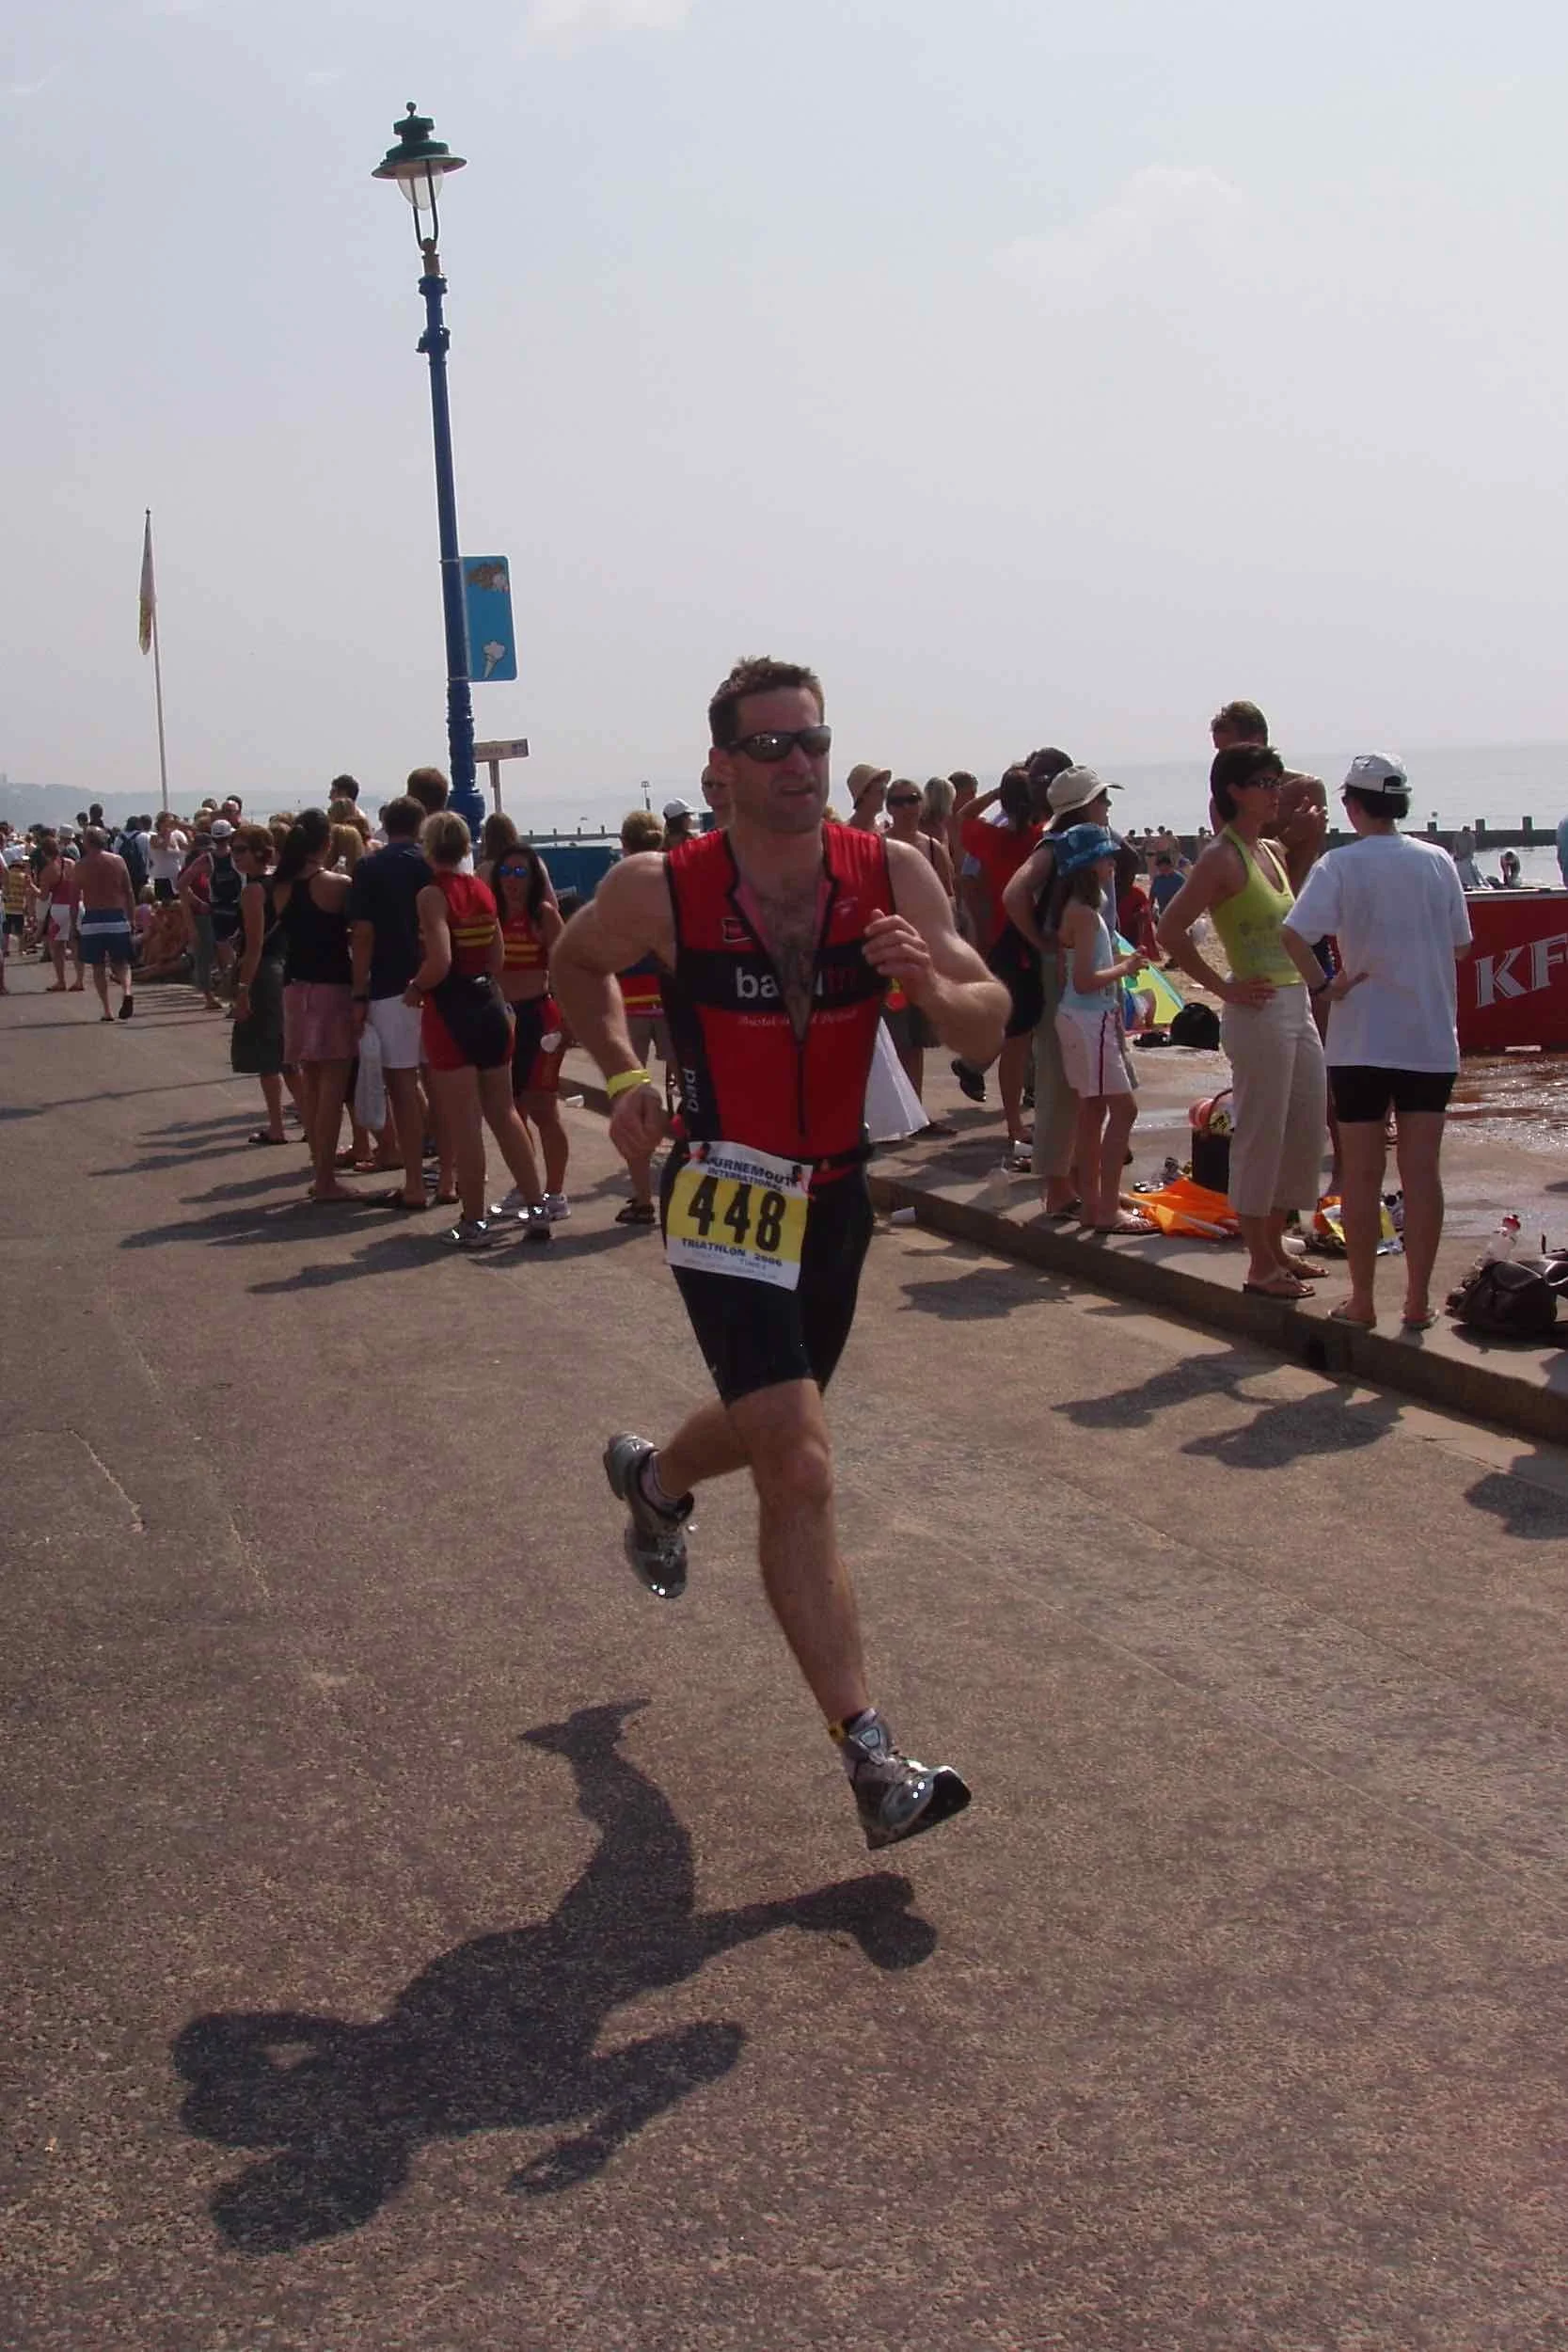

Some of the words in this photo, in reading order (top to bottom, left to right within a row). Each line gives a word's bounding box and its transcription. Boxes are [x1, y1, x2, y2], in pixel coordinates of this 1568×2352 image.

[1474, 931, 1568, 1009] KF
[706, 1156, 798, 1187] OURNEMOUT
[687, 1174, 787, 1252] 448
[681, 1238, 746, 1257] TRIATHLON
